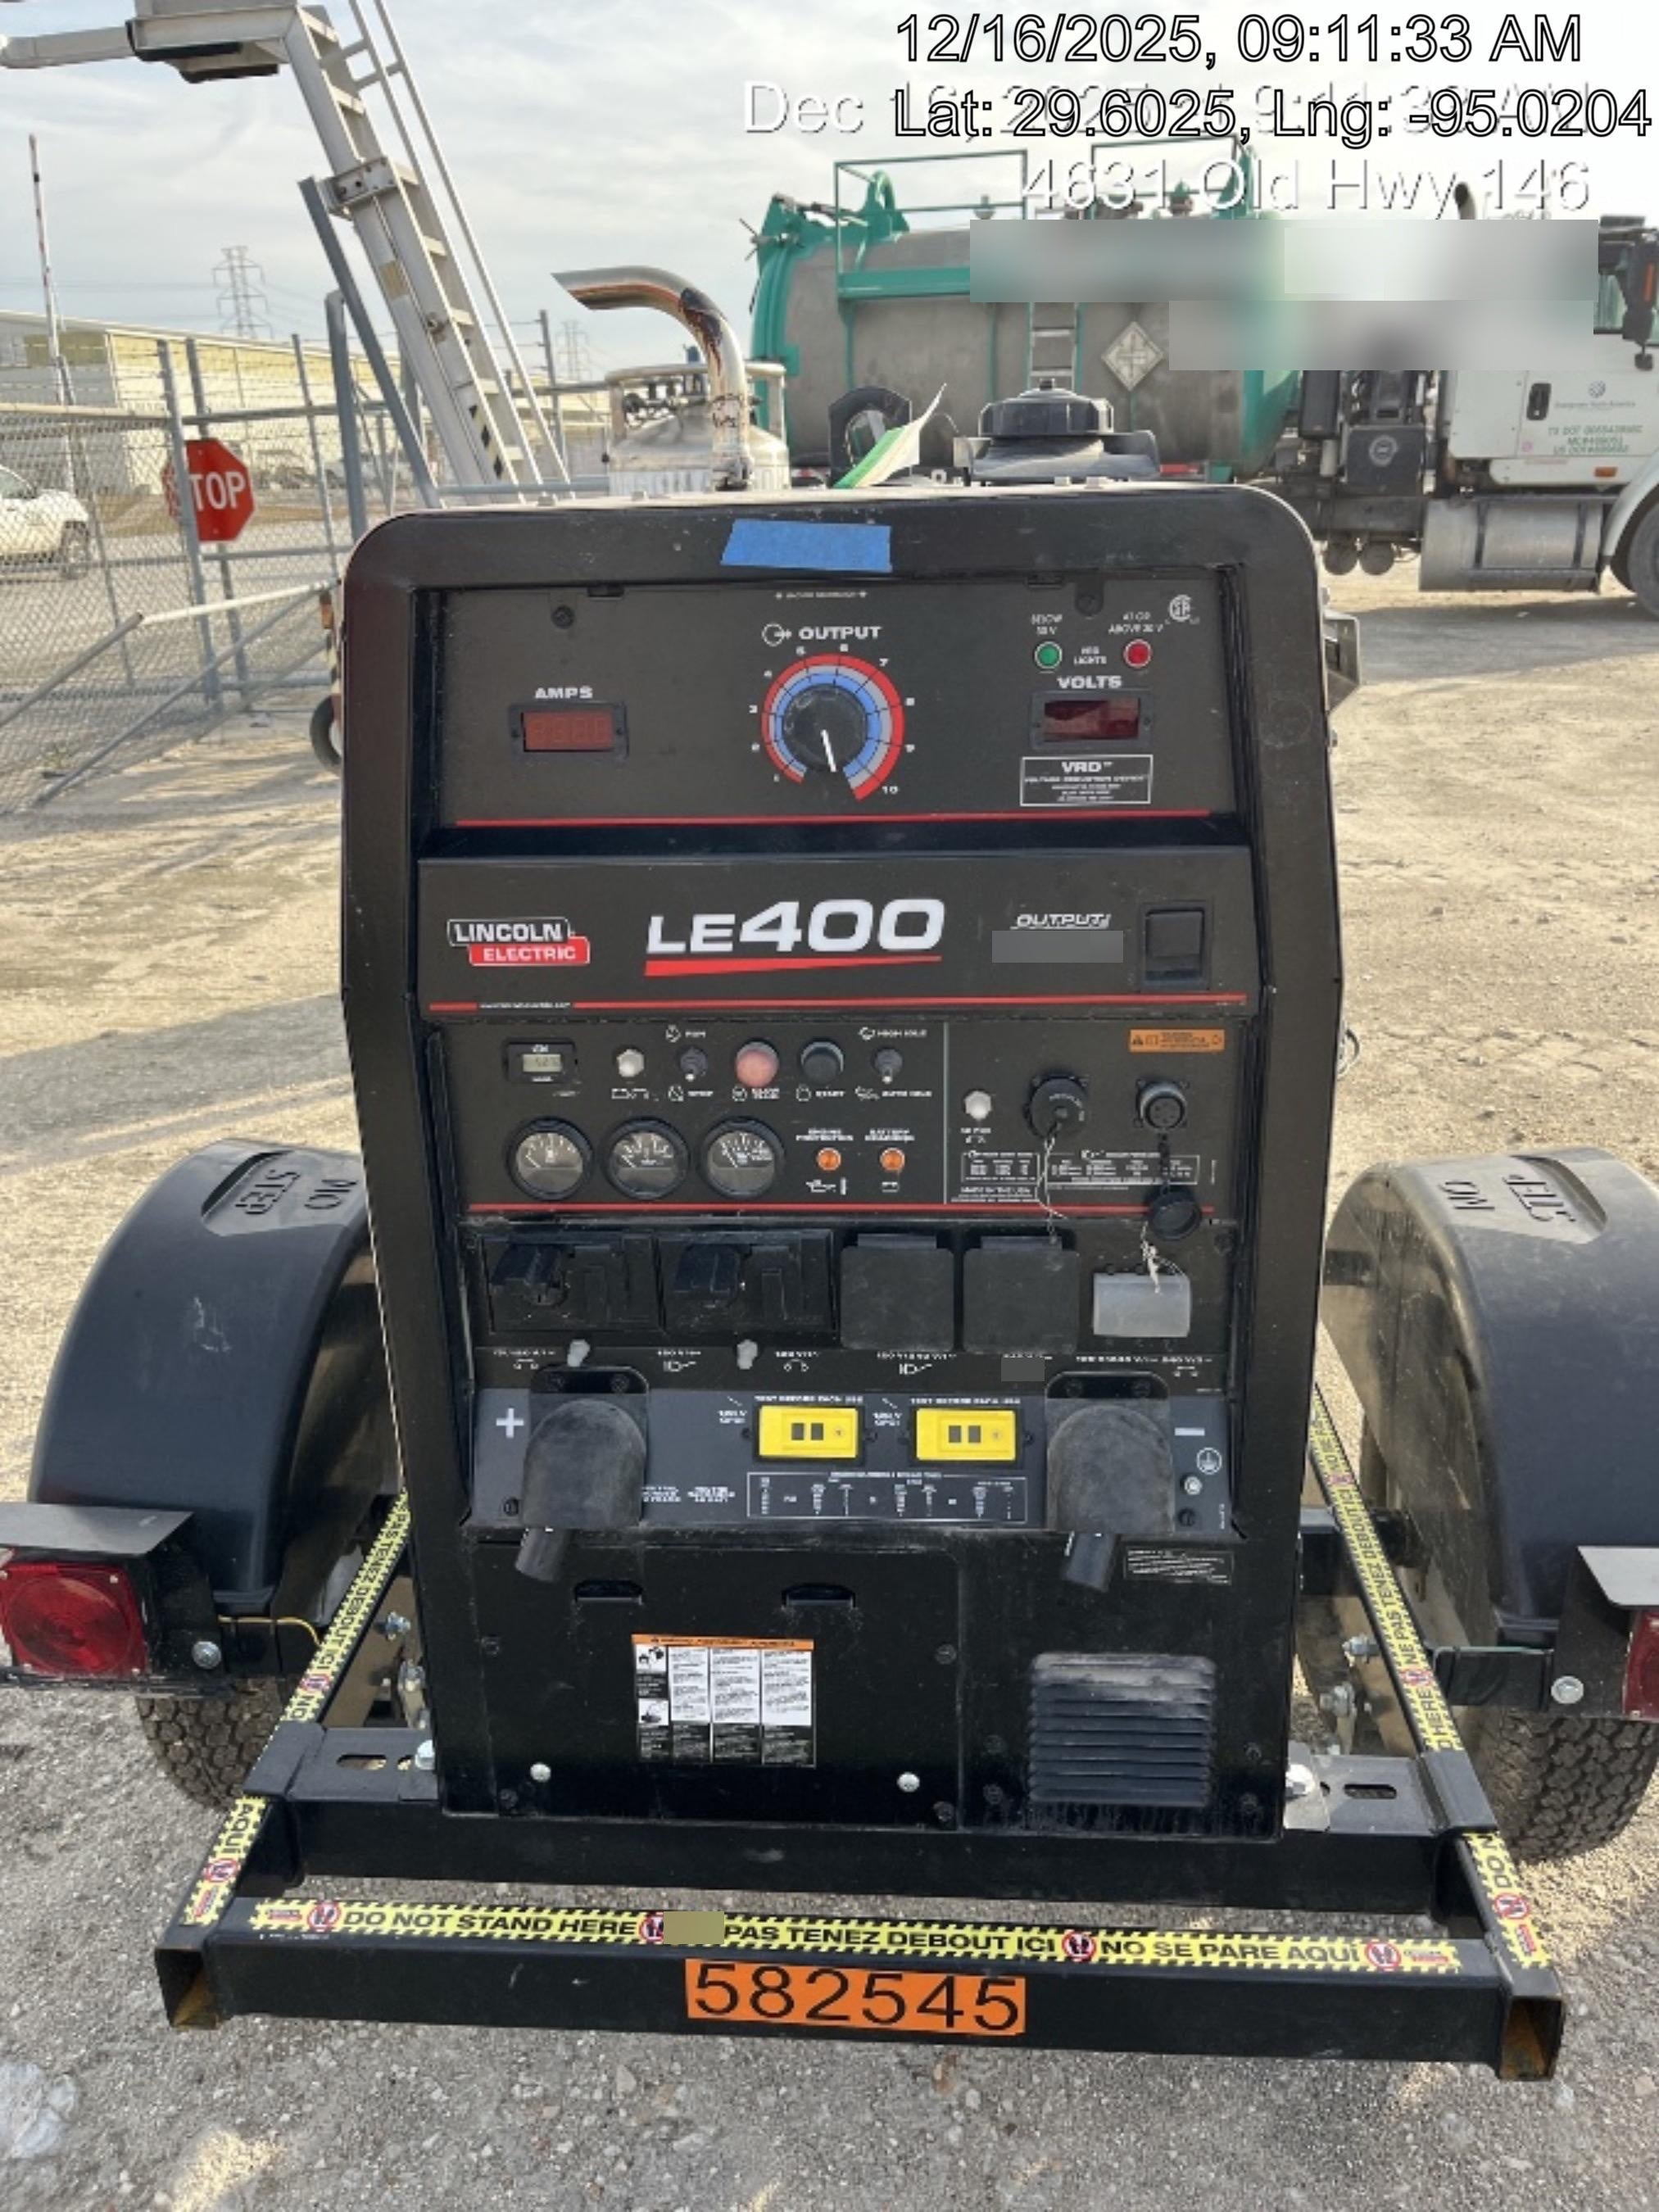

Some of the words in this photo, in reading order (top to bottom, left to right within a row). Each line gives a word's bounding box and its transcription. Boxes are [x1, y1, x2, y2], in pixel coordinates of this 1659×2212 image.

[798, 625, 882, 641] OUTPUT
[879, 658, 889, 667] 7
[1057, 676, 1122, 689] VOLTS
[534, 687, 594, 700] AMPS
[882, 786, 899, 794] 10
[454, 923, 563, 942] LINCOLN
[646, 899, 945, 954] LE400
[483, 946, 576, 962] ELECTRIC
[343, 1911, 386, 1926] DO
[392, 1913, 453, 1928] NOT
[456, 1914, 553, 1932] STAND
[559, 1919, 637, 1935] HERE
[724, 1924, 779, 1941] PAS
[786, 1927, 881, 1946] TENEZ
[888, 1931, 1010, 1952] DEBOUT
[1018, 1936, 1056, 1953] ICI
[1100, 1940, 1145, 1956] NO
[1154, 1942, 1193, 1957] SE
[1199, 1943, 1280, 1960] PARE
[695, 1962, 1018, 2032] 582545
